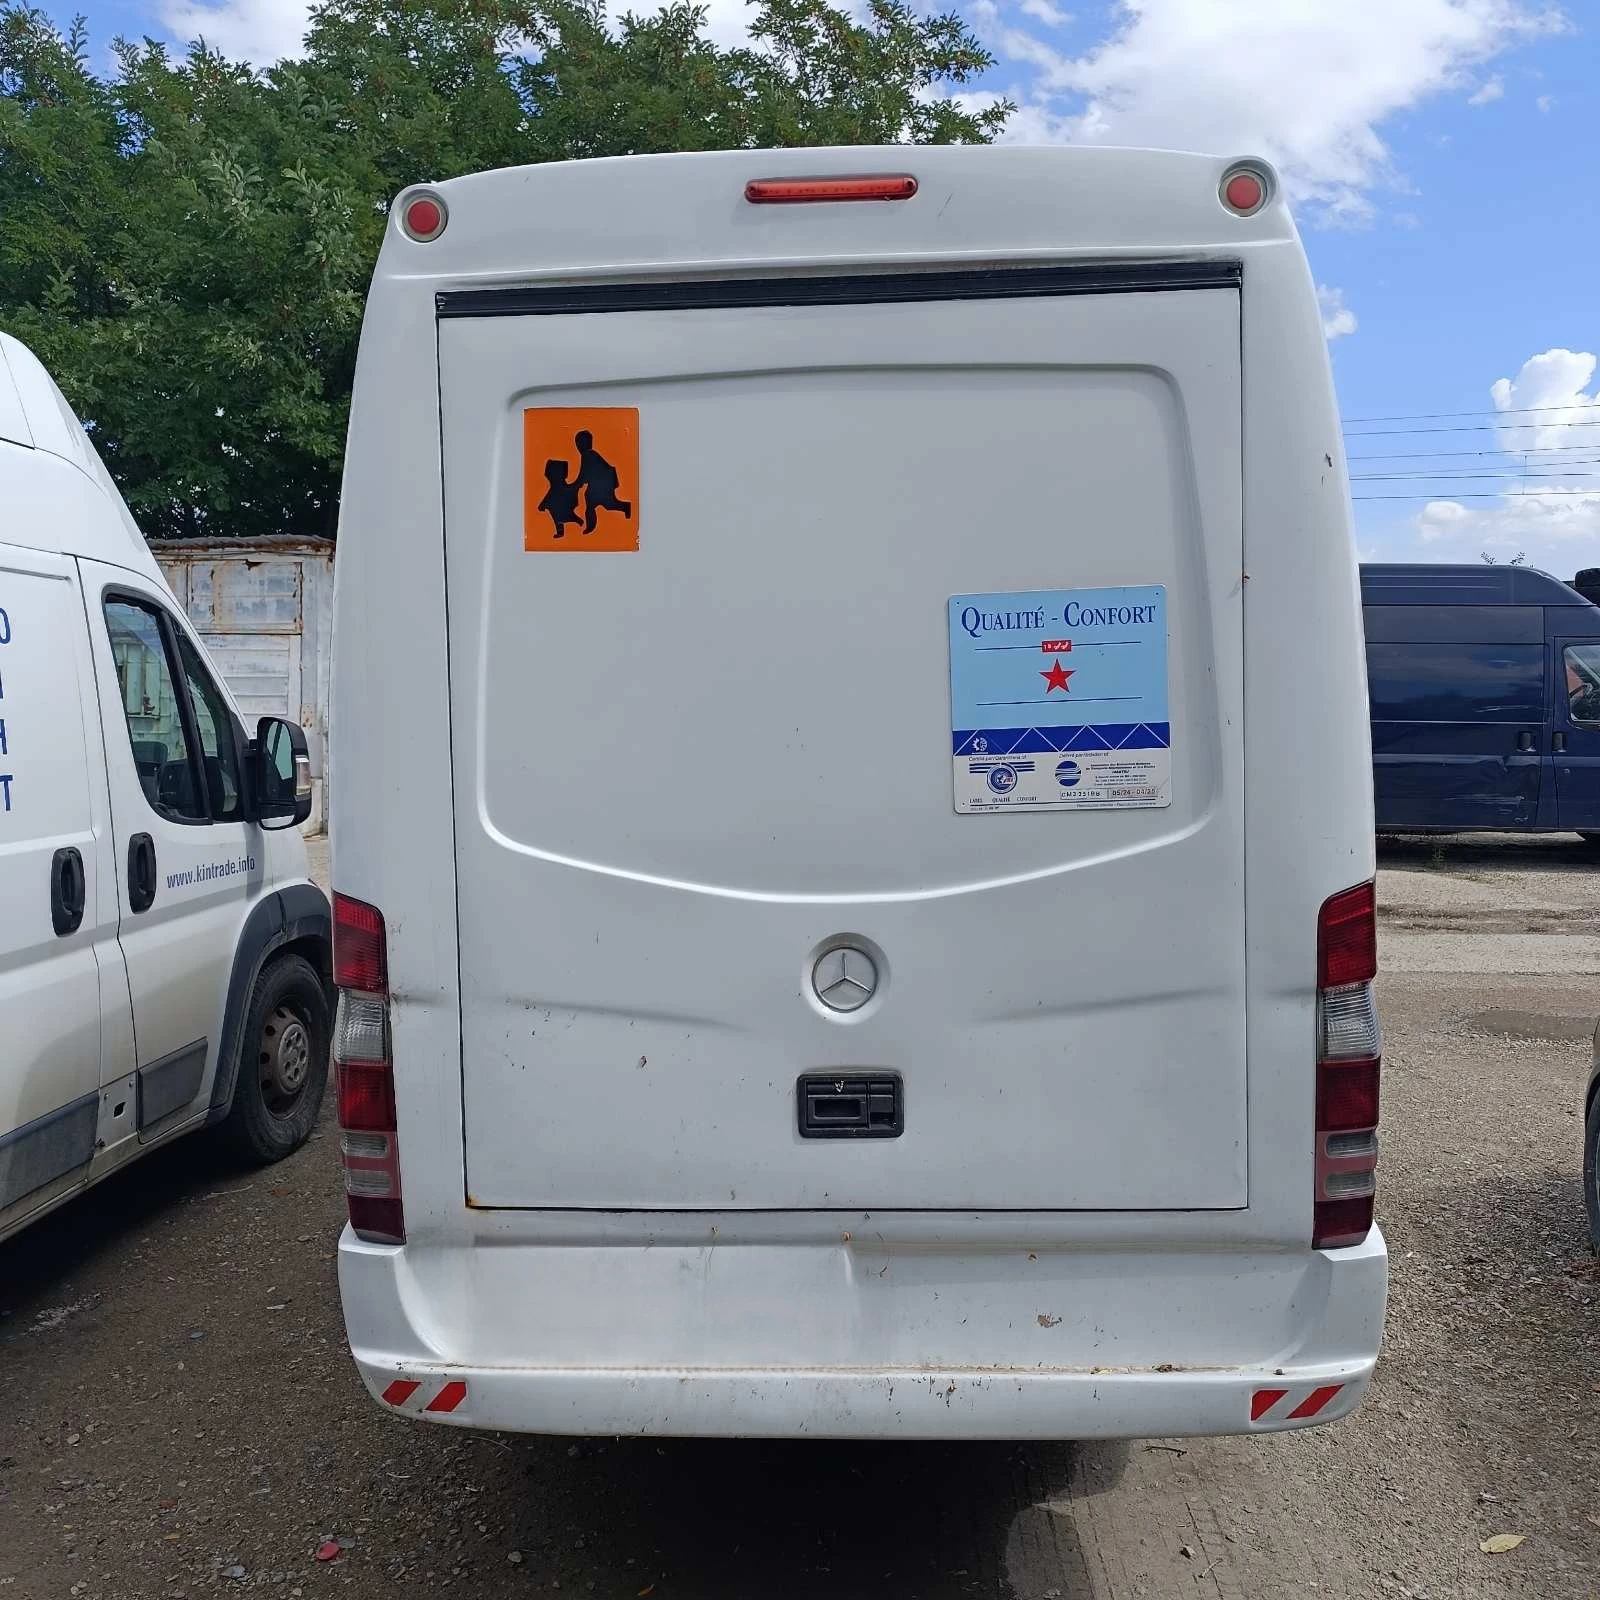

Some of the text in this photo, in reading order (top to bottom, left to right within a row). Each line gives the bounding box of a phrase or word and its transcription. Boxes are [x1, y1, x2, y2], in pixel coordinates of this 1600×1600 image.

[961, 606, 1045, 638] QUALITÉ
[1063, 602, 1156, 627] CONFORT
[167, 855, 255, 889] www.kintrade.info
